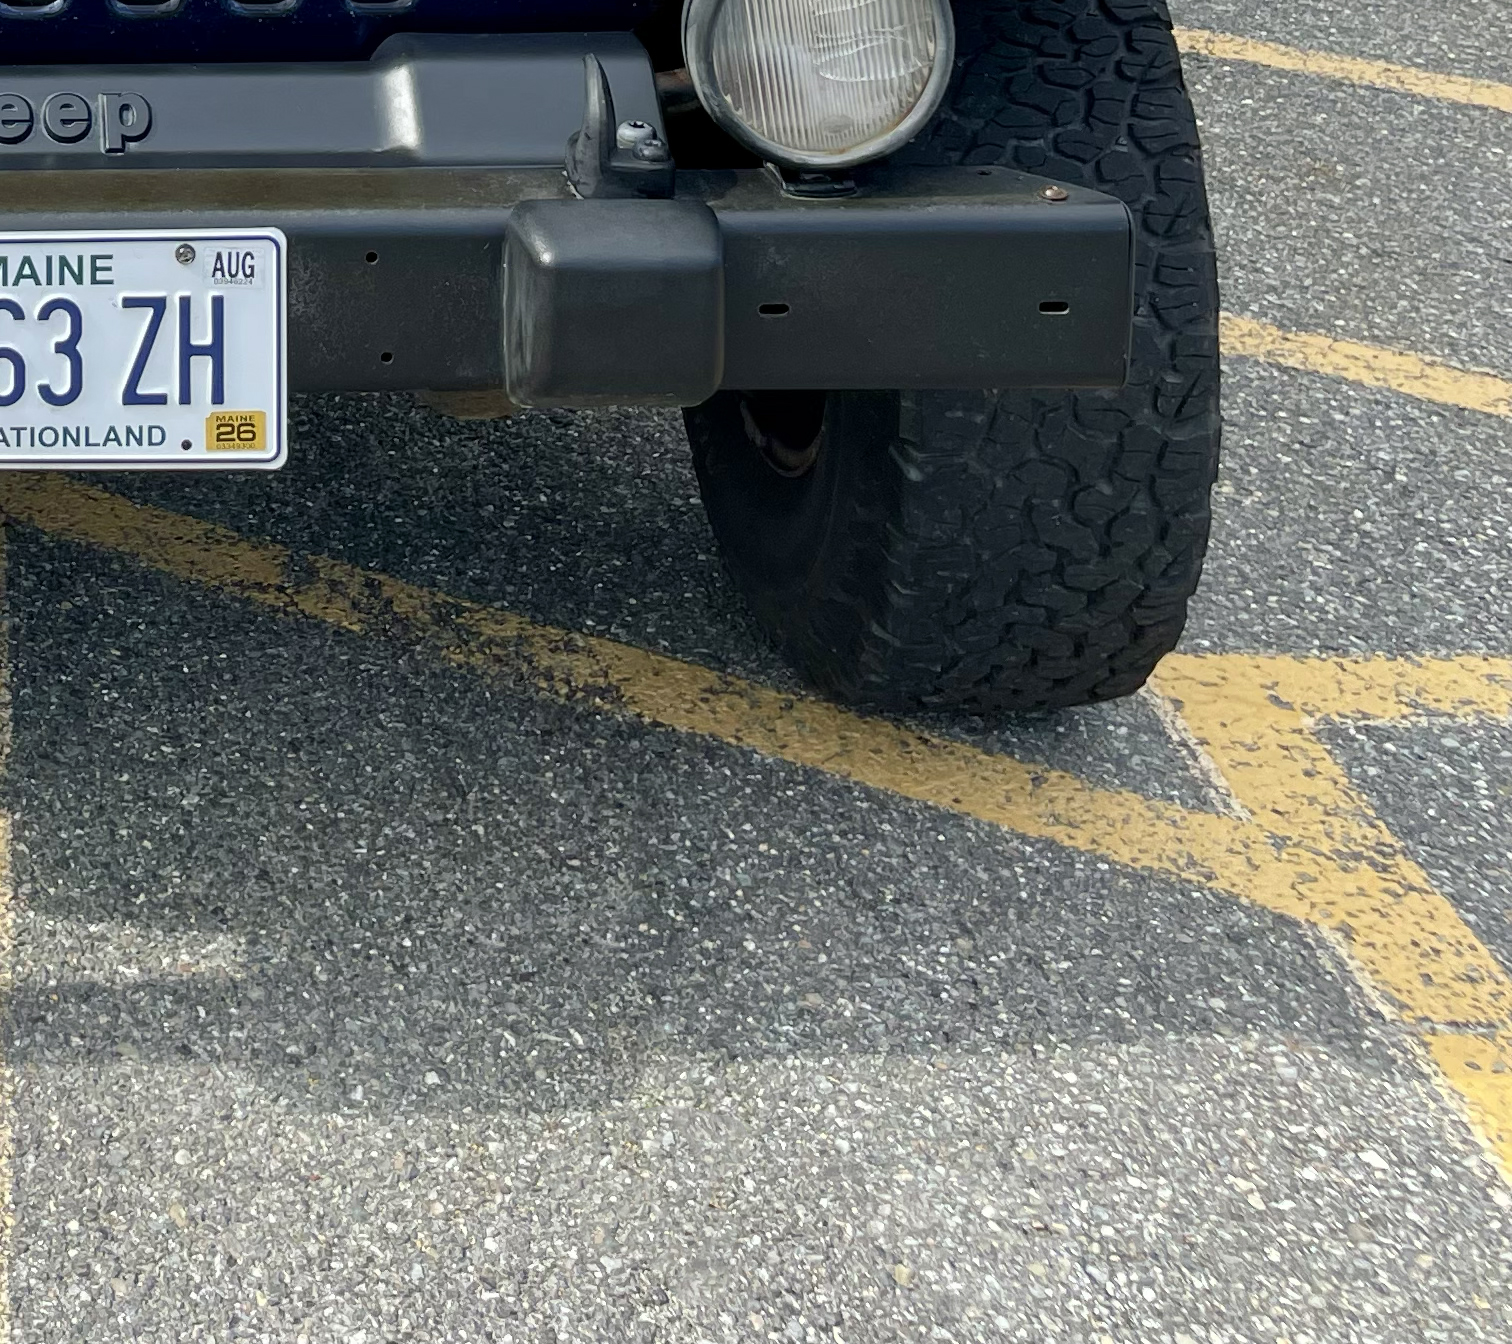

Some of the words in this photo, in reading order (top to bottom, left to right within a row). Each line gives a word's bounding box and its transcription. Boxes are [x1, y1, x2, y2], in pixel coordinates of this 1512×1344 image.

[211, 251, 255, 278] AUG
[122, 296, 225, 406] ZH
[216, 415, 256, 423] MAINE
[216, 422, 256, 442] 26
